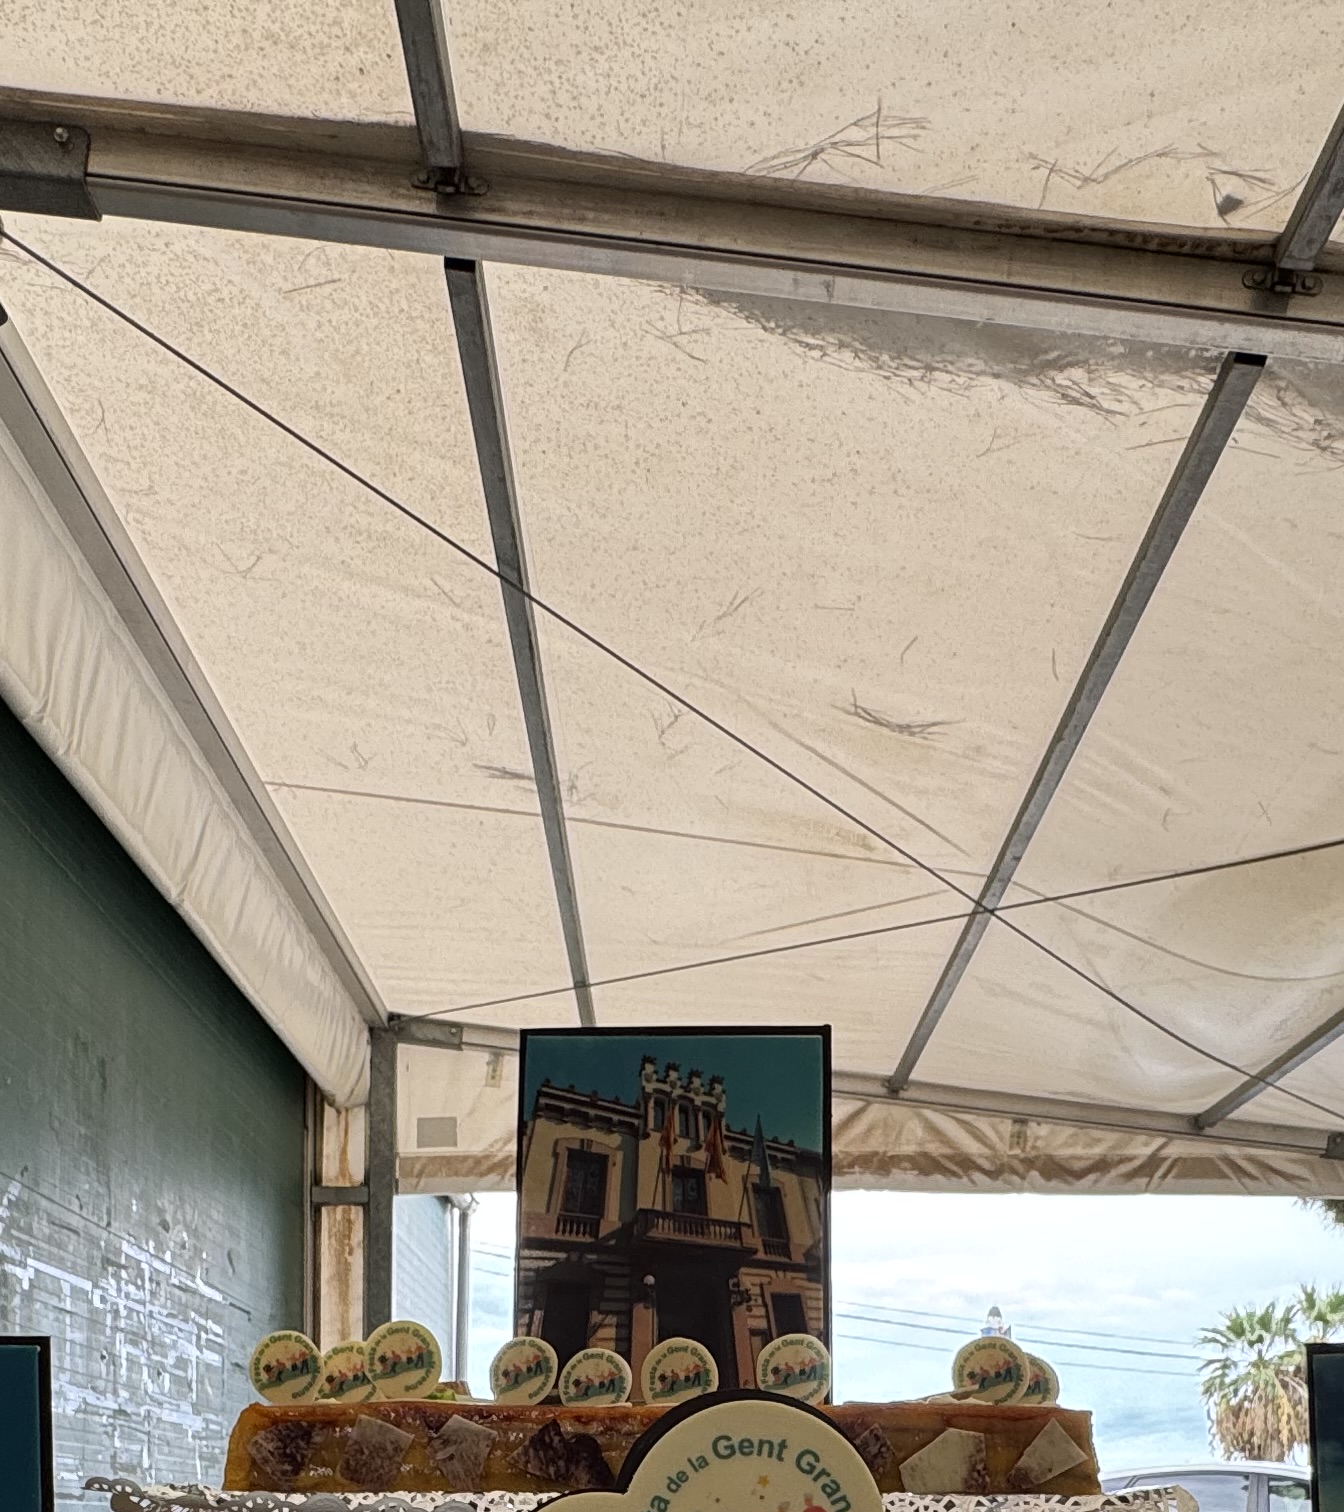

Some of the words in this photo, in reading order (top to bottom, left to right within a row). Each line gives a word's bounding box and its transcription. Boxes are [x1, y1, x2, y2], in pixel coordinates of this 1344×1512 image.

[666, 1470, 689, 1494] de
[686, 1453, 709, 1473] la
[711, 1434, 788, 1462] Gent
